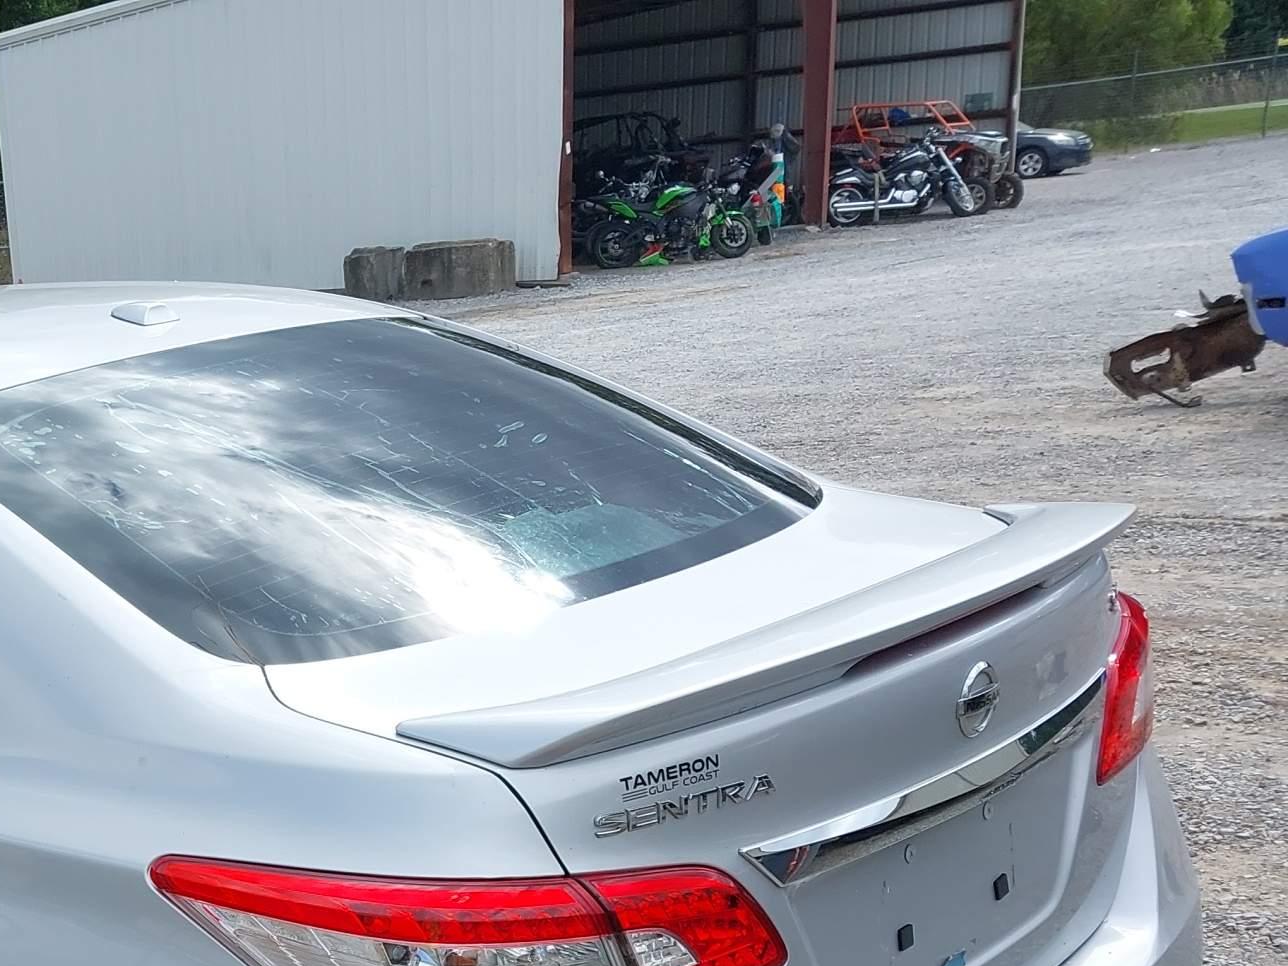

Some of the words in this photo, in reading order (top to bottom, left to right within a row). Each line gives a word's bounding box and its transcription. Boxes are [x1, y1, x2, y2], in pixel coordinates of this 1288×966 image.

[619, 753, 720, 791] TAMERON
[648, 779, 680, 797] GULF
[682, 769, 721, 787] COAST
[593, 772, 777, 839] SENTRA
